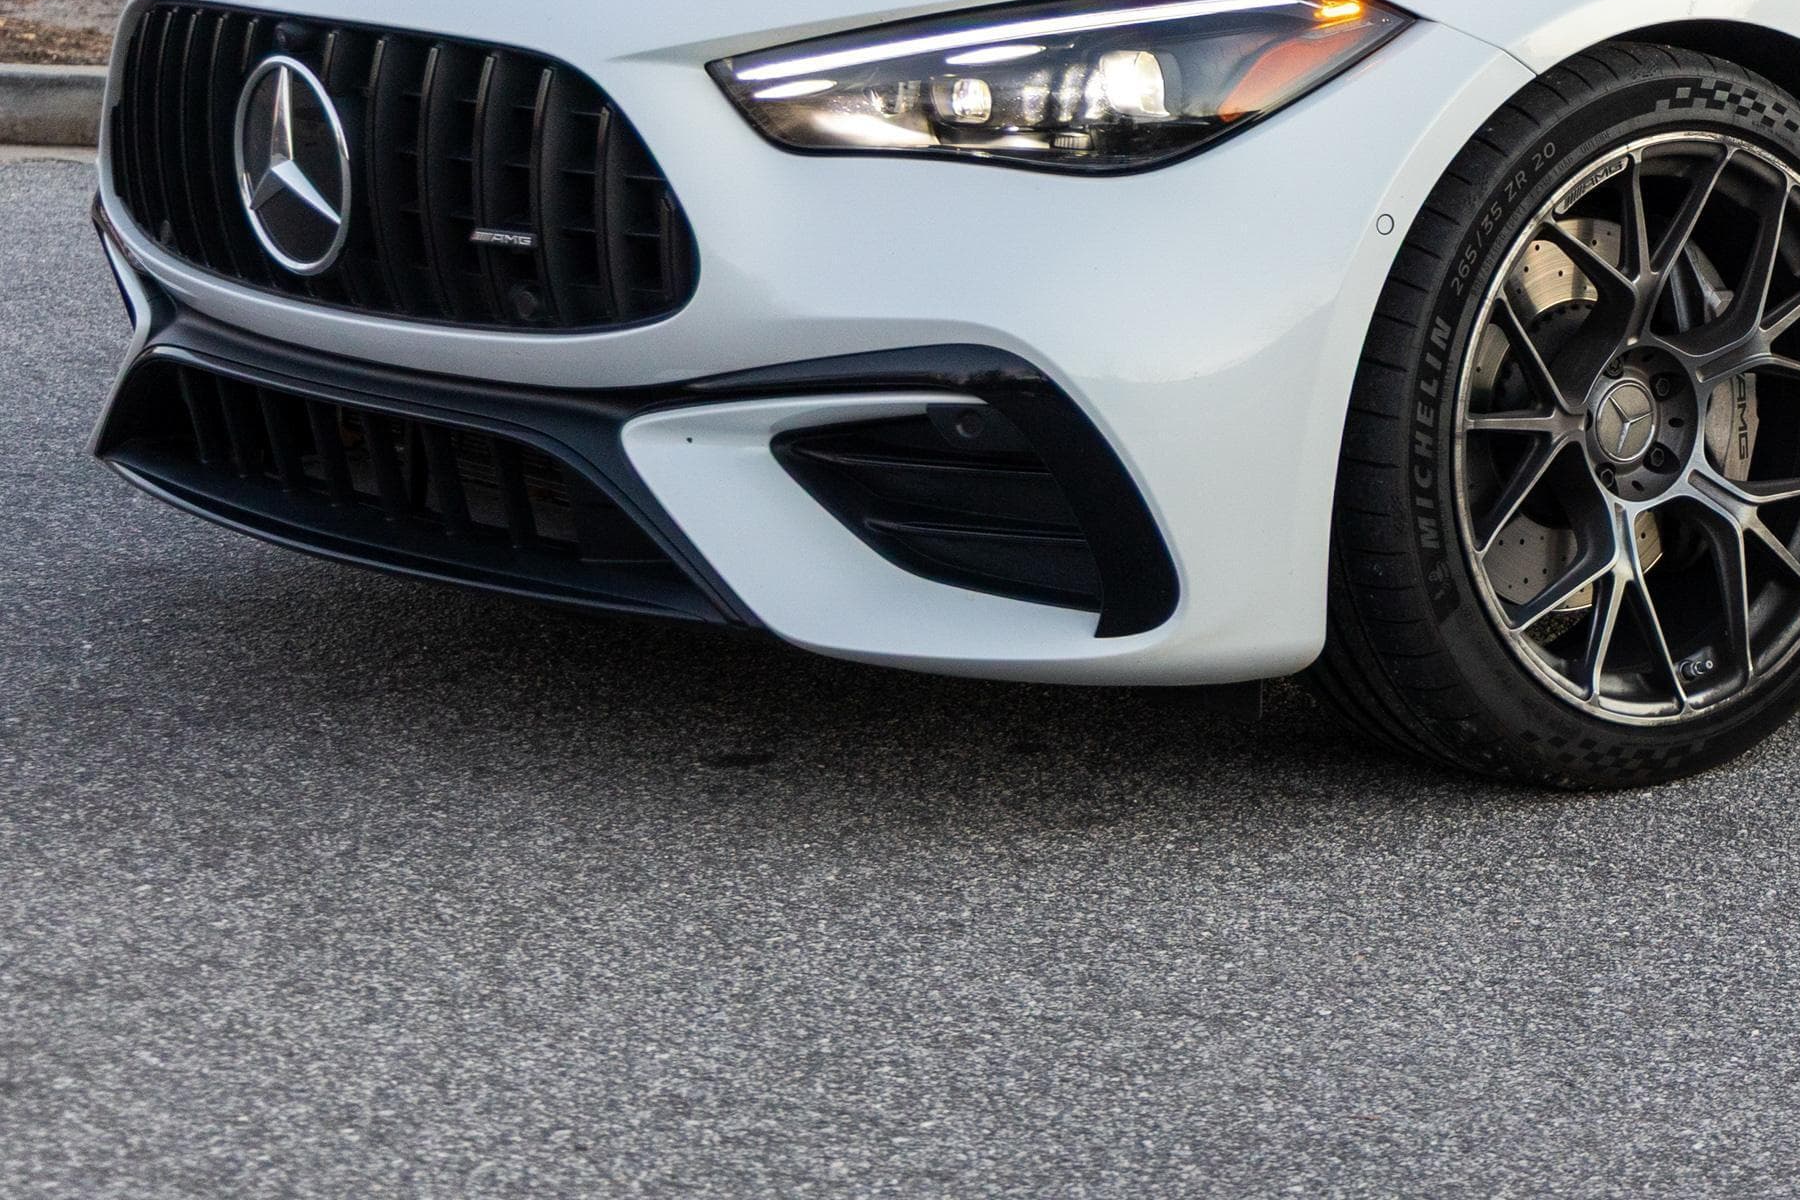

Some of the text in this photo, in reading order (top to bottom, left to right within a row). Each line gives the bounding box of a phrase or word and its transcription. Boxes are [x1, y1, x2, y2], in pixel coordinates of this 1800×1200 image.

[1450, 201, 1503, 296] 265/35
[1503, 169, 1528, 203] ZR
[1531, 141, 1557, 172] 20
[1413, 315, 1452, 551] MICHELIN
